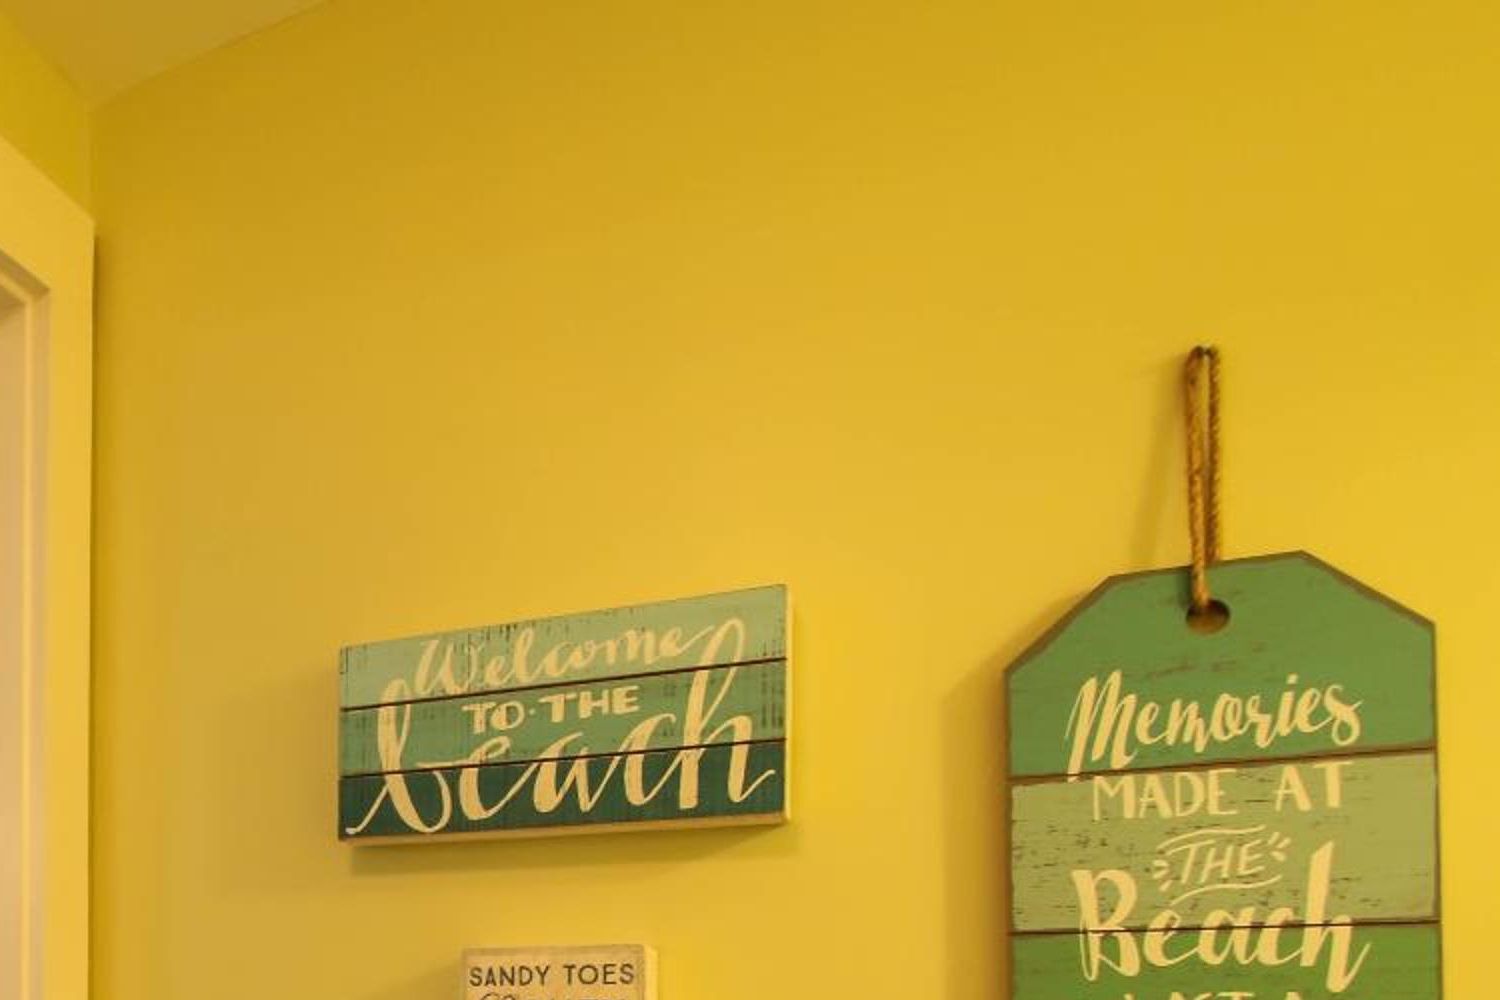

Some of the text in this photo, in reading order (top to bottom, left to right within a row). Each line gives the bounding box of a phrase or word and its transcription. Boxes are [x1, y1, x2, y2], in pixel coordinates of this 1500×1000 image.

[412, 626, 716, 697] Welcome
[345, 617, 776, 834] beach
[462, 686, 640, 734] TO THE
[1065, 669, 1363, 783] Memories
[1092, 761, 1354, 820] MADE AT
[1165, 838, 1267, 884] THE
[1070, 841, 1371, 992] Beach
[469, 963, 635, 987] SANDY TOES
